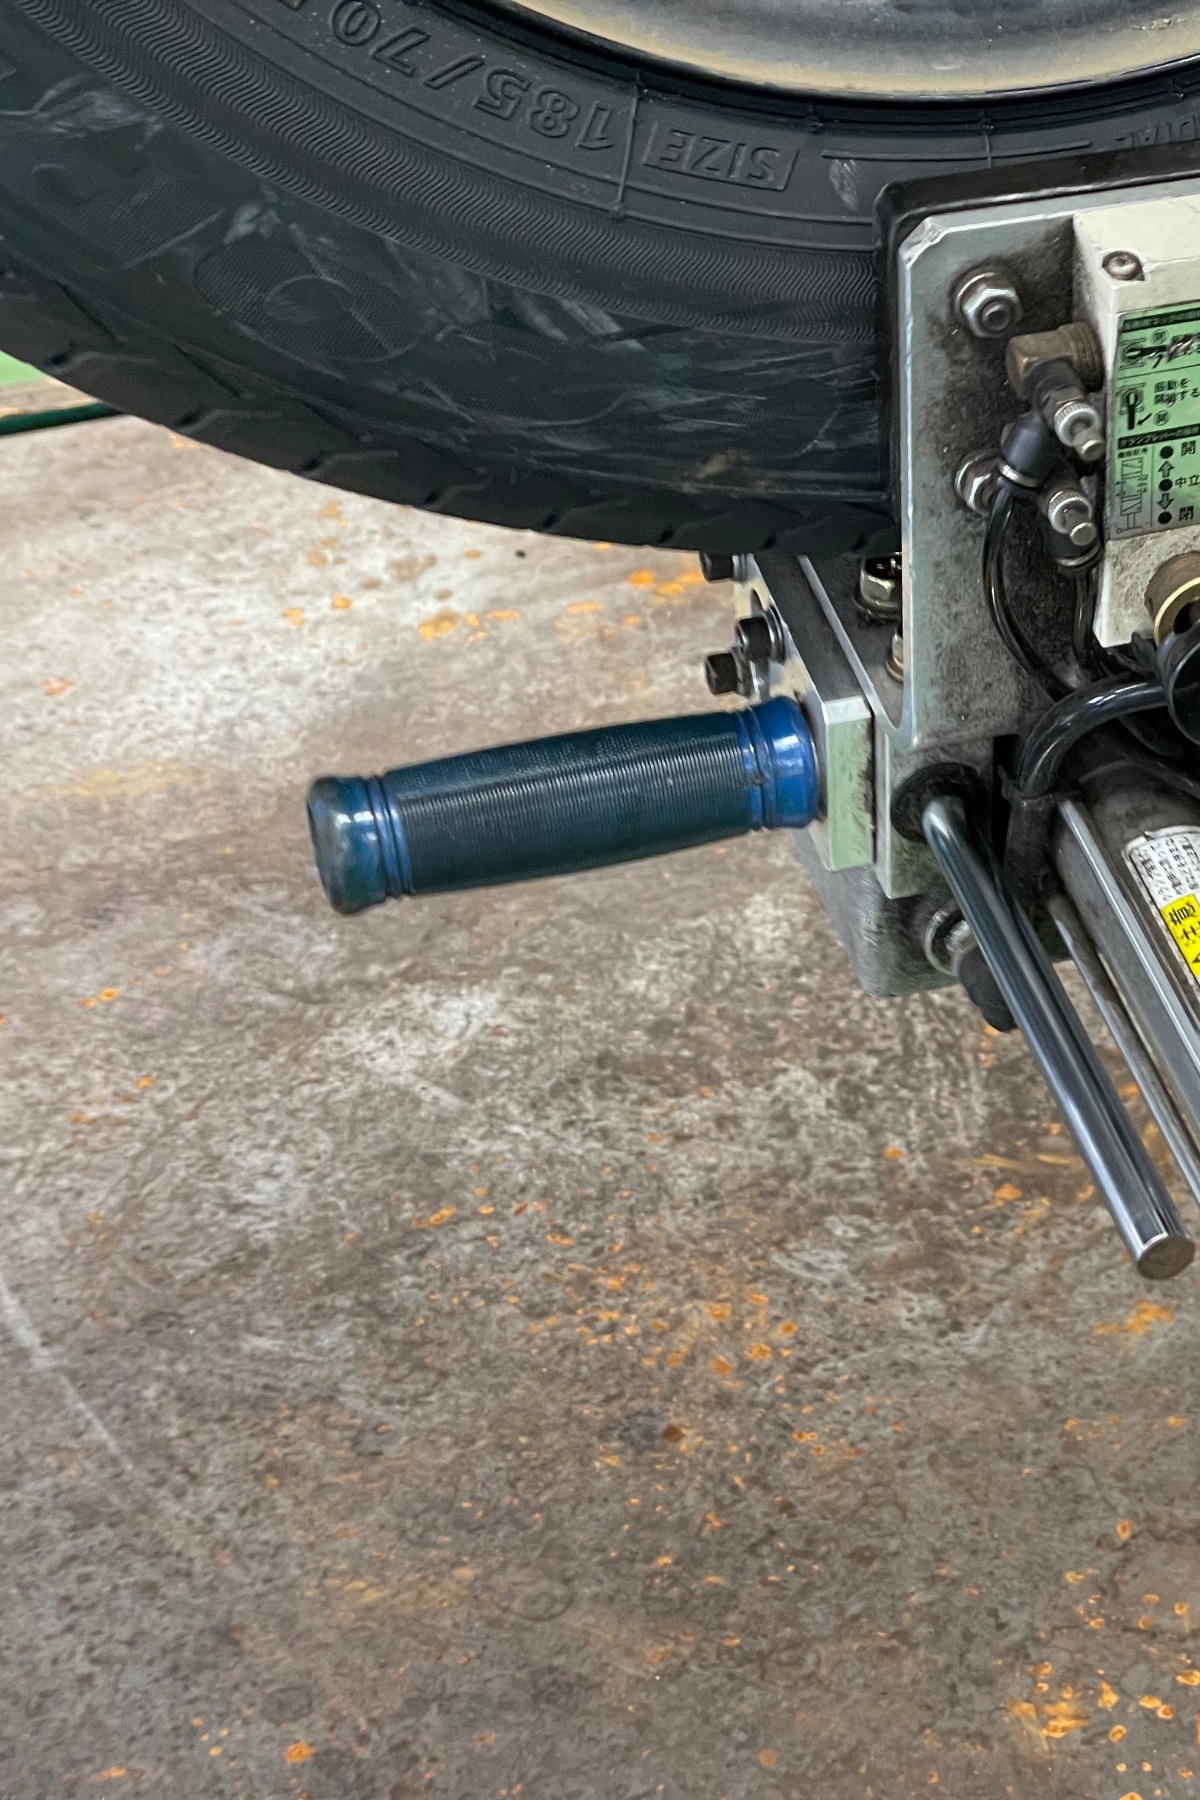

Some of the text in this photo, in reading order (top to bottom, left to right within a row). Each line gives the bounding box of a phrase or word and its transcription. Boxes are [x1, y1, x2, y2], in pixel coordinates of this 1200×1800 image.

[329, 0, 782, 183] SIZE 185/70
[1174, 474, 1200, 488] 中立
